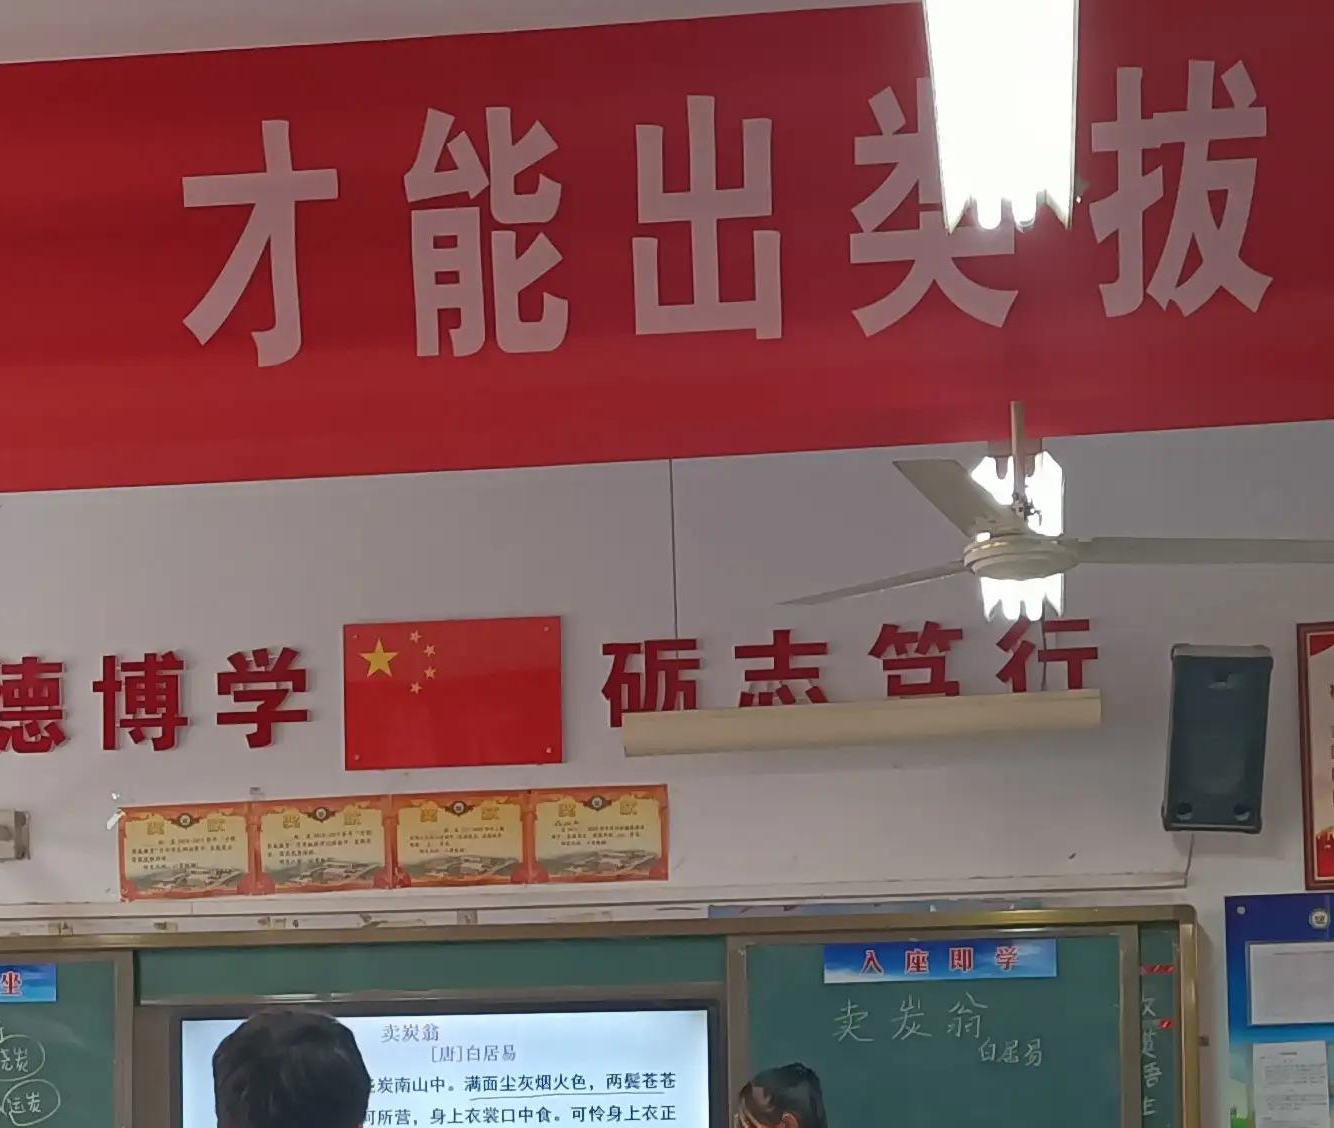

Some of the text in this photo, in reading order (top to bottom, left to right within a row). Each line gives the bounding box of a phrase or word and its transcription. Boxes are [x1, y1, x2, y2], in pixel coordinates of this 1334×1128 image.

[860, 946, 1021, 976] 入座即学
[832, 992, 988, 1044] 卖炭翁
[380, 1024, 440, 1043] 卖炭翁
[977, 1036, 1044, 1067] 白居易
[370, 1072, 677, 1094] 炭南山中。满面尘灰烟火色，两鬓苍苍
